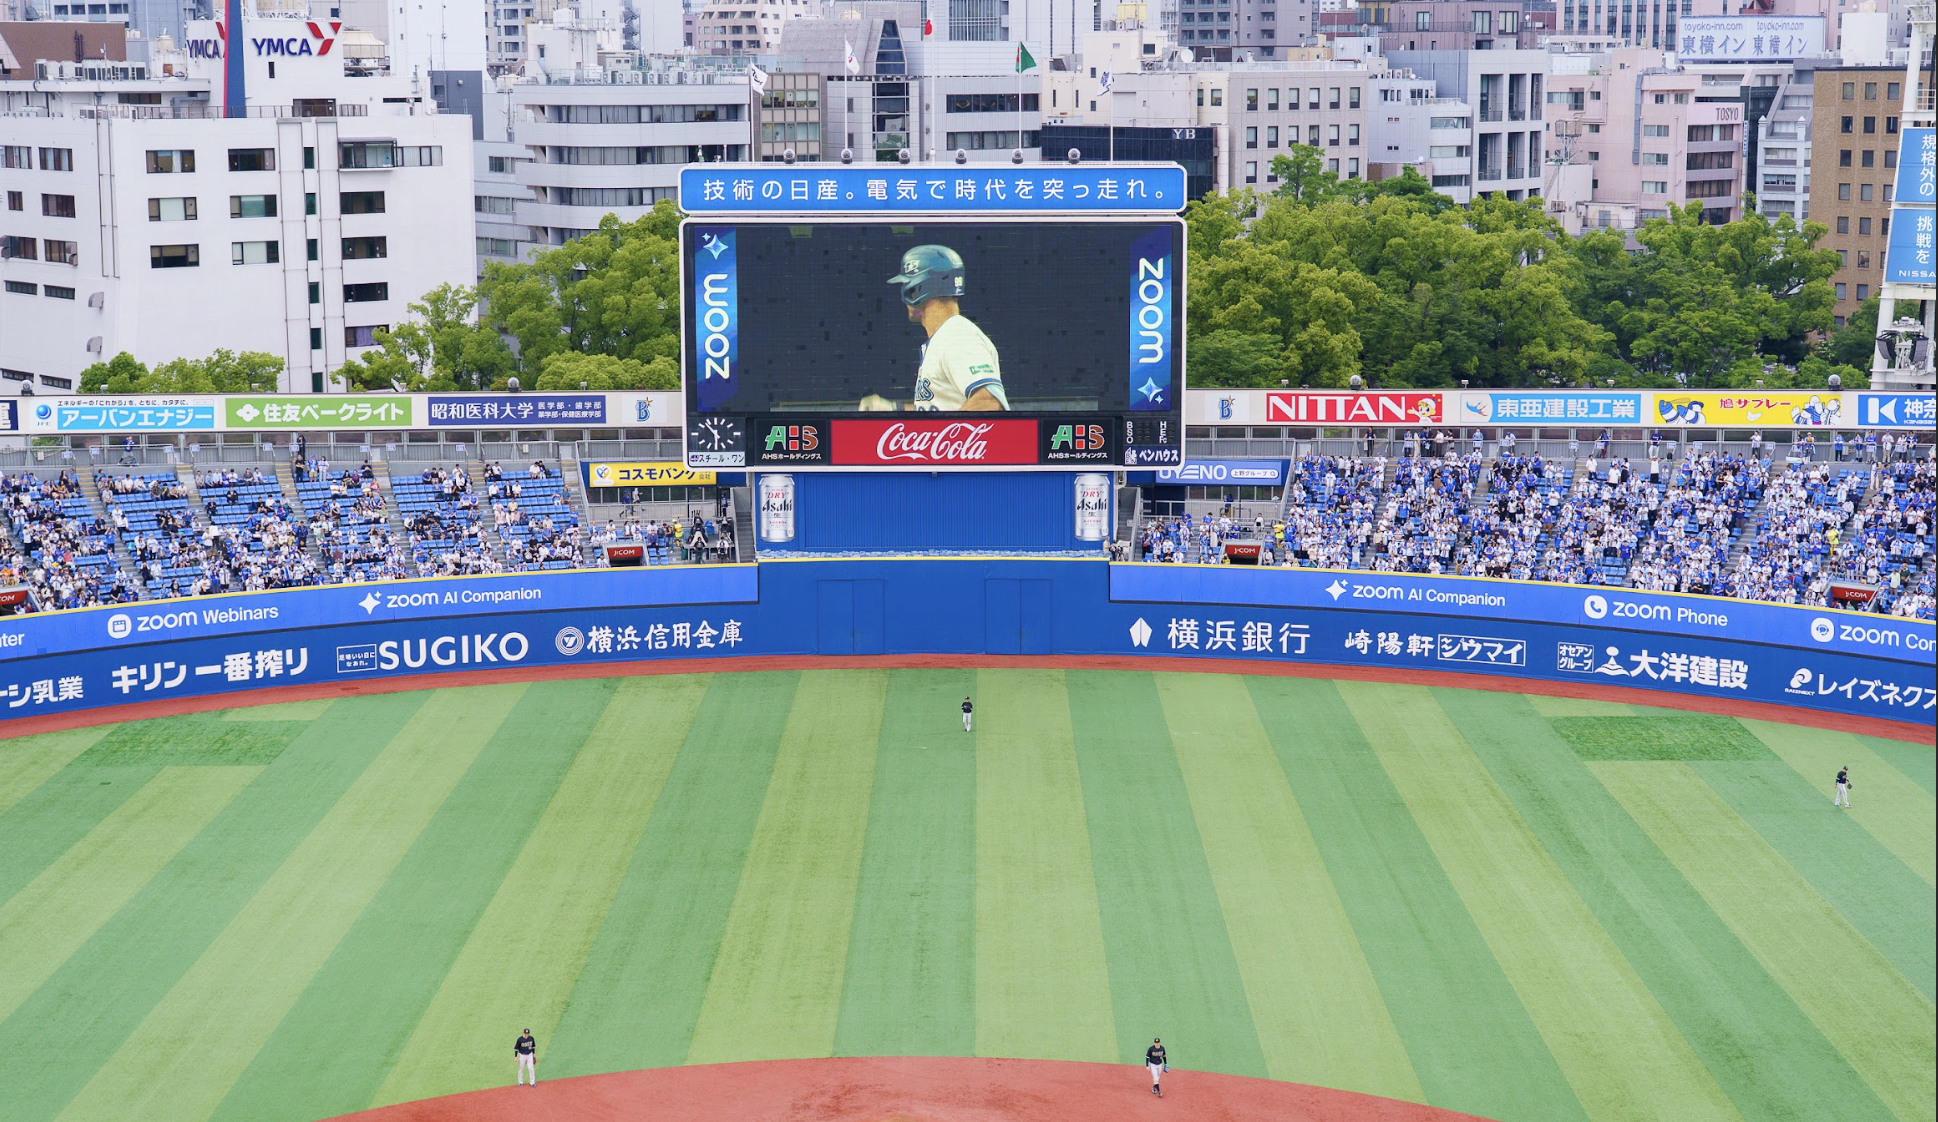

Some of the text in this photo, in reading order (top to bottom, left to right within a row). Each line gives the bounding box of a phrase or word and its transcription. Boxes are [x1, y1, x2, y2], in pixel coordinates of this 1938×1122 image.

[1684, 21, 1742, 32] toyoko-inn.com
[1757, 20, 1804, 32] toyoko-inn.com
[186, 39, 221, 59] YMCA
[252, 38, 312, 56] YMCA
[1681, 35, 1746, 55] 東横イン
[1752, 34, 1808, 56] 東横イン
[1716, 107, 1738, 121] TOSYO
[1920, 134, 1936, 196] 規格外の
[703, 178, 1164, 201] 技術の日産。電気で時代を突っ走れ。
[1916, 215, 1933, 265] 挑戦を
[1138, 257, 1164, 364] zoom
[703, 274, 730, 380] zoom
[262, 402, 404, 422] 住友ベークライト
[431, 402, 534, 420] 昭和医科大学
[538, 402, 602, 410] 医学部・歯学部
[1269, 396, 1406, 420] NITTAN
[1497, 398, 1635, 418] 東亜建設工業
[1719, 398, 1792, 409] 鳩サブレー
[62, 408, 212, 428] アーバンエナジー
[876, 422, 994, 460] Coca-Cola
[699, 454, 745, 462] スチール・ワン
[619, 468, 696, 480] コスモバンク
[762, 499, 792, 512] Asahi
[1077, 498, 1106, 510] Asahi
[386, 588, 542, 608] zoom AI Companion
[1352, 584, 1506, 606] zoom AI Companion
[137, 606, 279, 632] zoom Webinars
[1612, 601, 1728, 626] zoom Phone
[586, 618, 743, 654] 横浜信用金庫
[1167, 618, 1310, 654] 横浜銀行
[1344, 629, 1435, 657] 崎陽軒
[1839, 624, 1900, 647] zoom
[378, 632, 529, 670] SUGIKO
[1440, 637, 1523, 664] シウマイ
[1559, 644, 1593, 657] オセアン
[1559, 656, 1593, 670] グループ
[1630, 649, 1748, 690] 大洋建設
